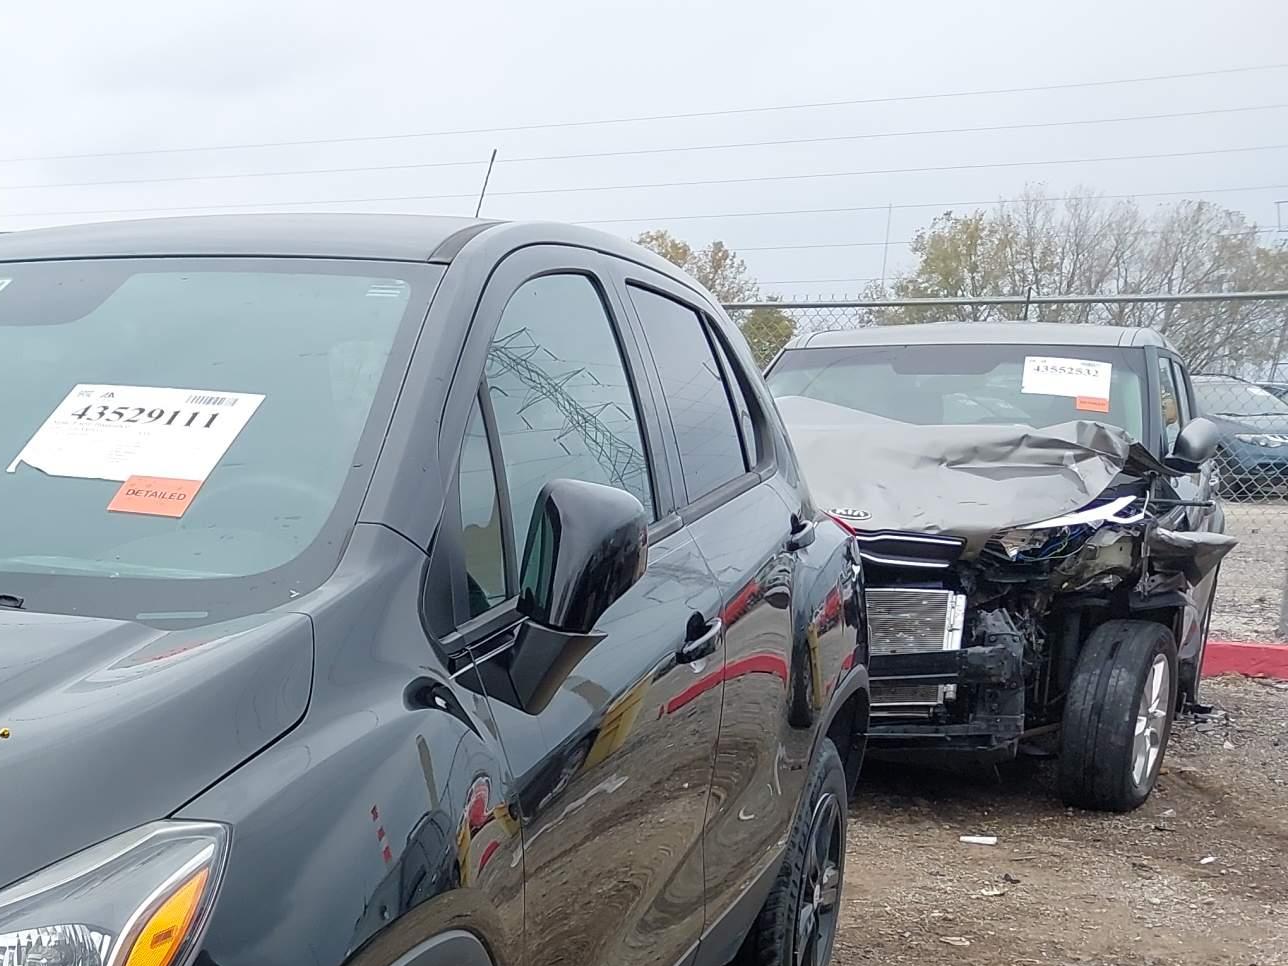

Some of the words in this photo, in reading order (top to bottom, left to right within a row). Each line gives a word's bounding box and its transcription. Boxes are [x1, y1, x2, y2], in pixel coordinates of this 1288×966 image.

[1033, 365, 1100, 377] 43552532
[71, 404, 220, 429] 43529111
[125, 488, 188, 502] DETAILED
